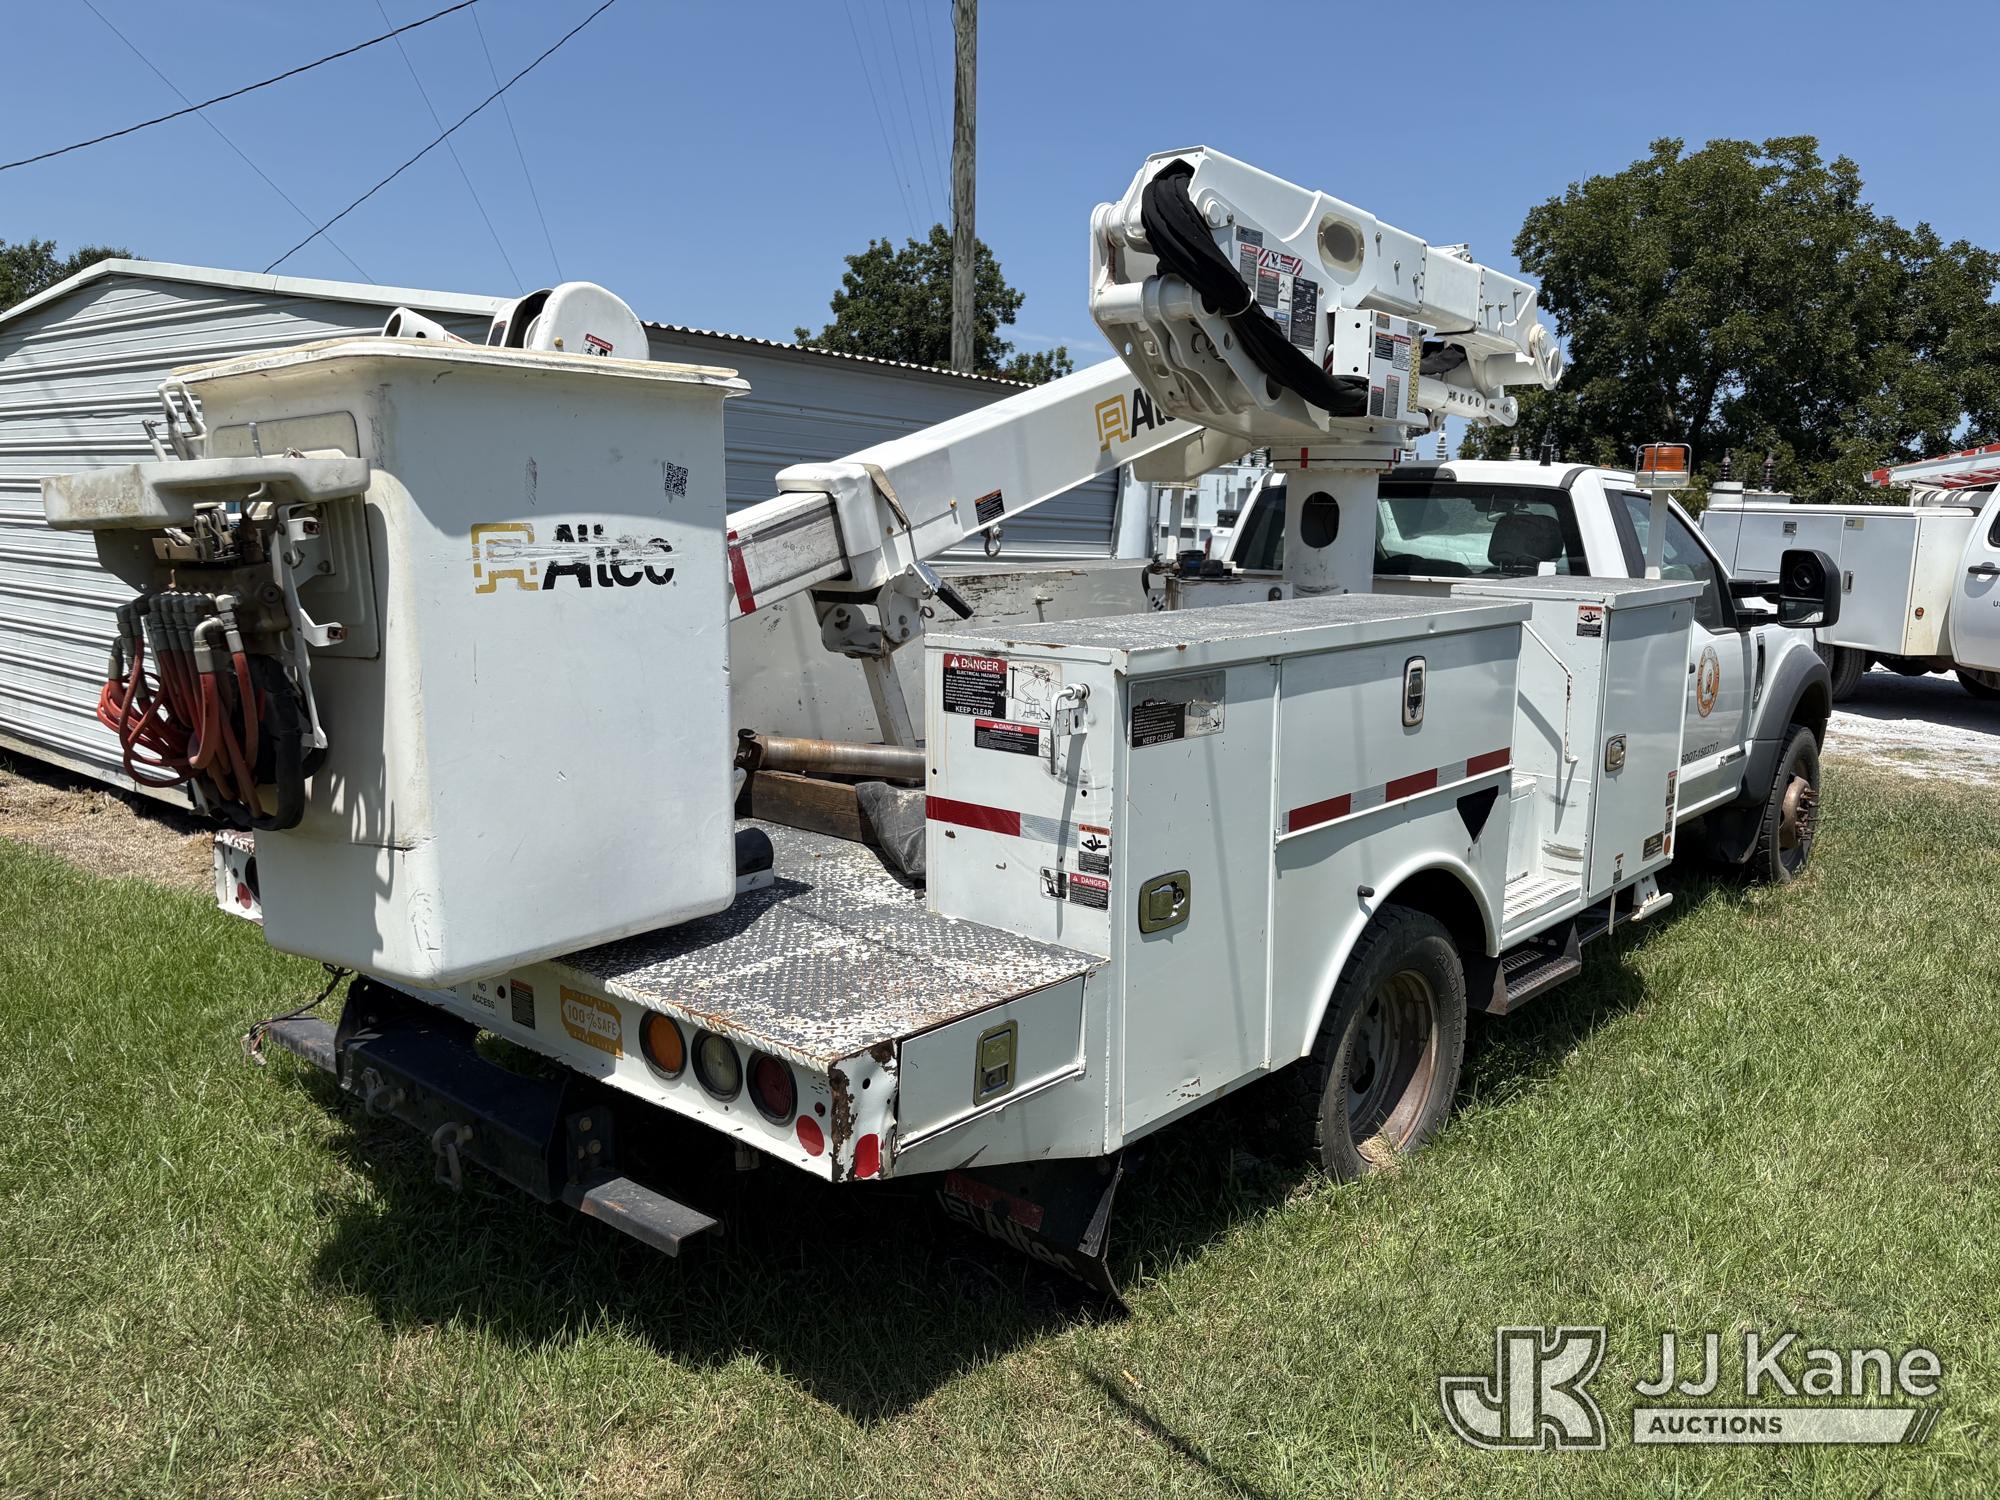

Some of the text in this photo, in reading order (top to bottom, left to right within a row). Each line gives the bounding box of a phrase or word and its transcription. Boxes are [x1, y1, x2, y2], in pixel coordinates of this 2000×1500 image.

[961, 658, 999, 671] DANGER
[972, 707, 992, 716] CLEAR
[998, 723, 1022, 732] DANGER
[1143, 732, 1174, 744] KEEP CLEAR
[1081, 877, 1107, 889] DANGER
[478, 981, 487, 992] NO
[472, 993, 495, 1009] ACCESS
[597, 1018, 617, 1036] SAFE
